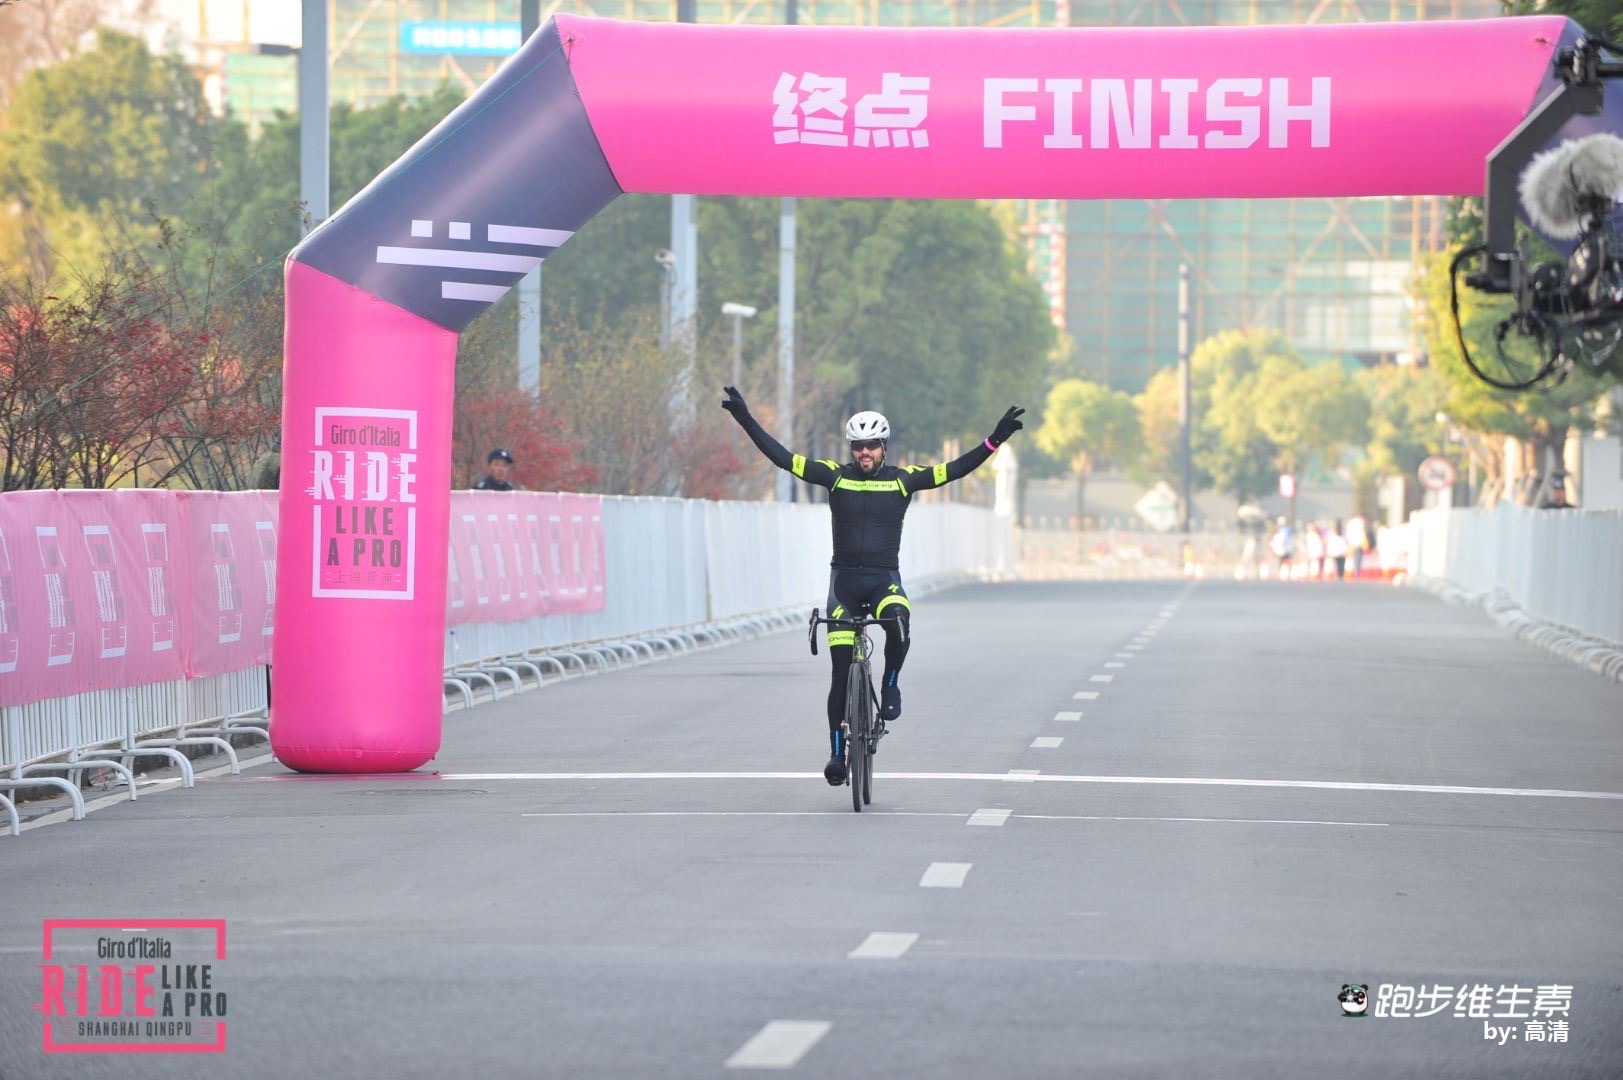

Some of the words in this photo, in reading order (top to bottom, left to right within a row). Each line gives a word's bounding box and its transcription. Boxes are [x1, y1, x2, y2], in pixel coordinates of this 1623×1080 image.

[773, 71, 930, 147] 终点
[983, 77, 1332, 149] FINISH
[331, 425, 356, 445] Giro
[359, 426, 400, 447] d'Italia
[307, 451, 416, 503] RIDE
[336, 506, 393, 535] LIKE
[327, 537, 340, 566] A
[353, 538, 401, 567] PRO
